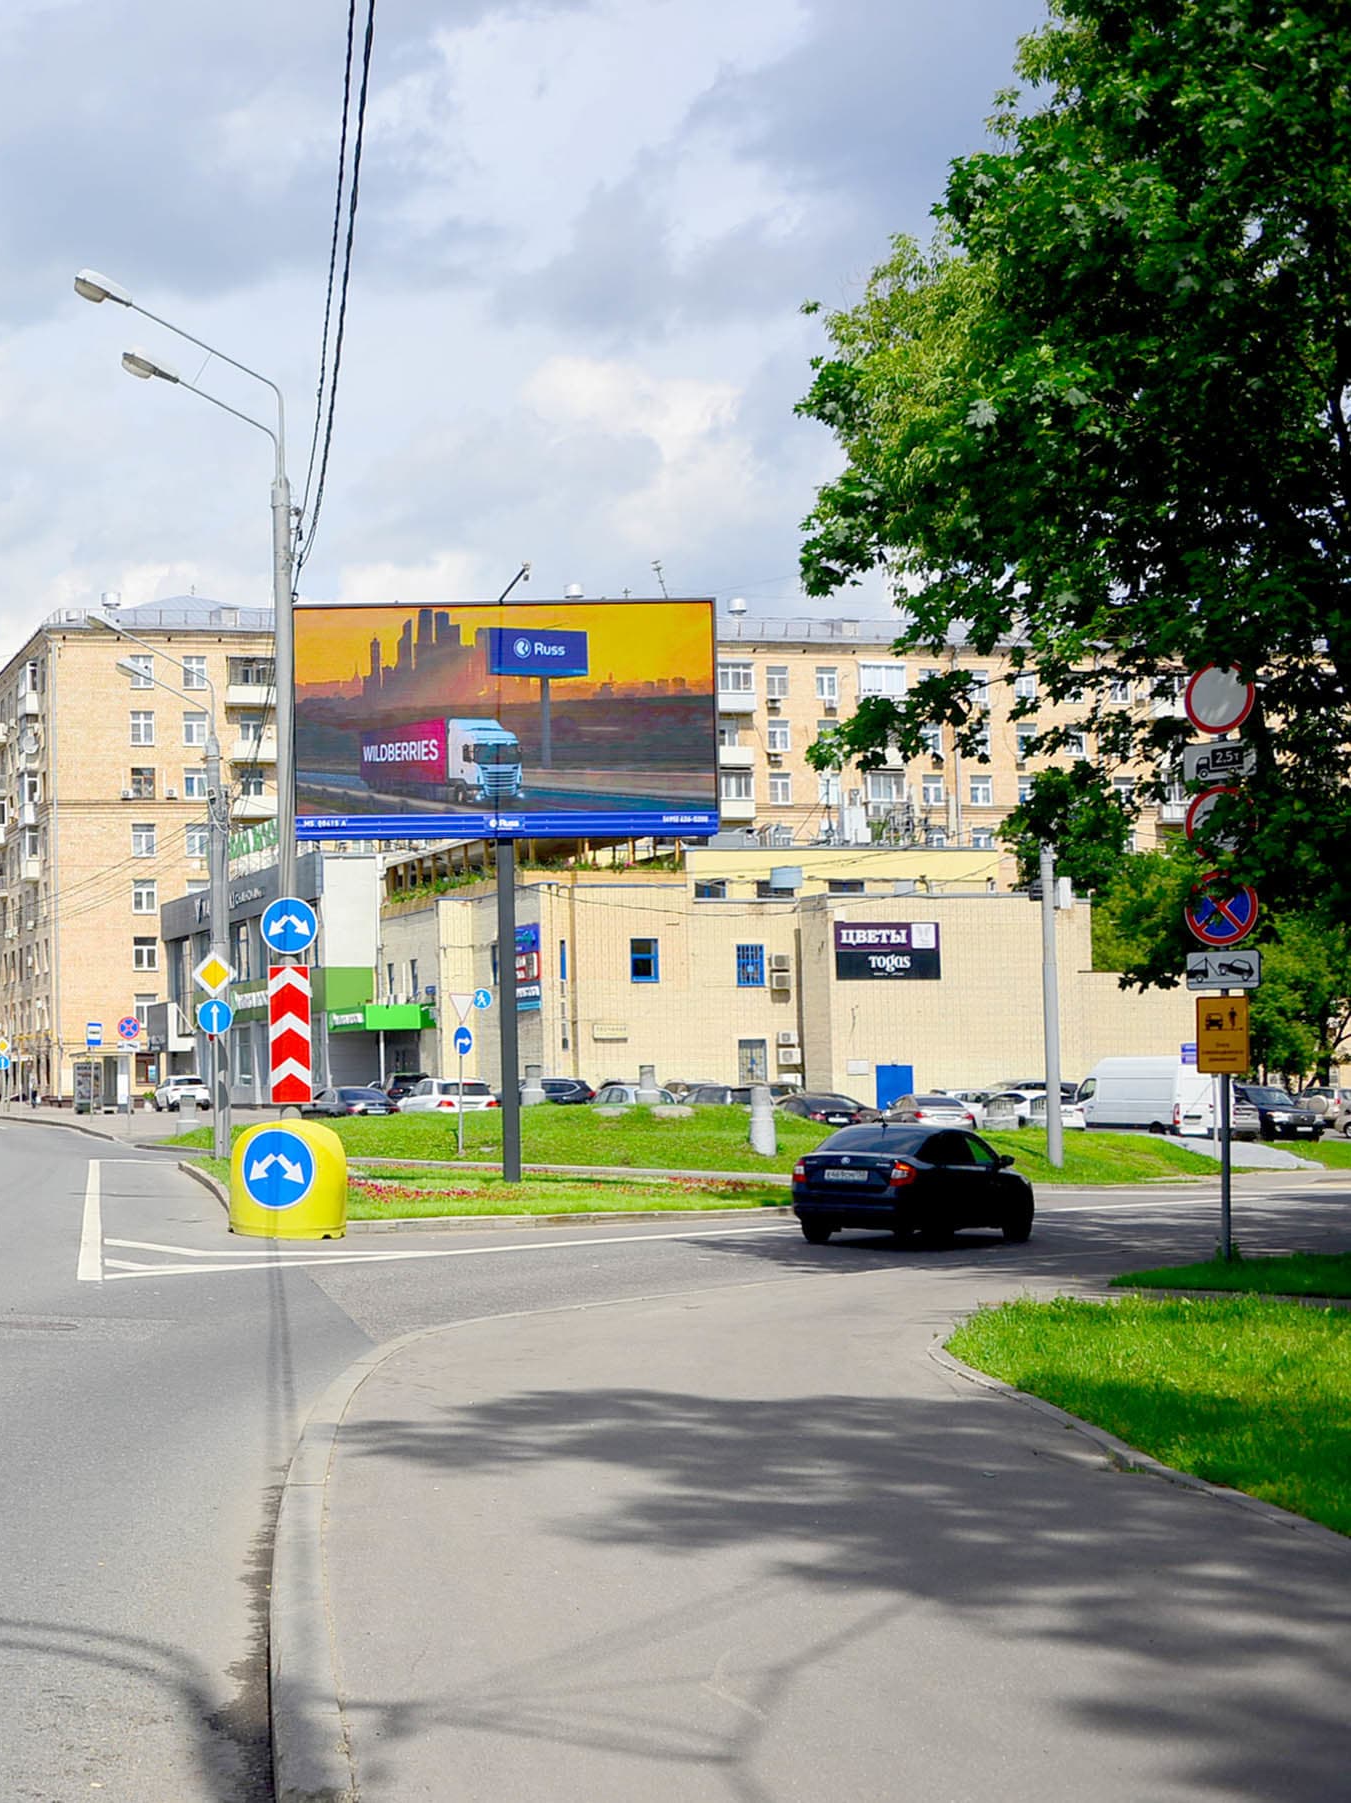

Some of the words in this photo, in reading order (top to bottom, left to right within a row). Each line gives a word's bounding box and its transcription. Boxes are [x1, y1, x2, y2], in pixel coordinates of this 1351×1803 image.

[534, 642, 566, 656] Russ
[362, 739, 439, 762] WILDBERRIES
[840, 929, 908, 946] ЦВЕТЫ
